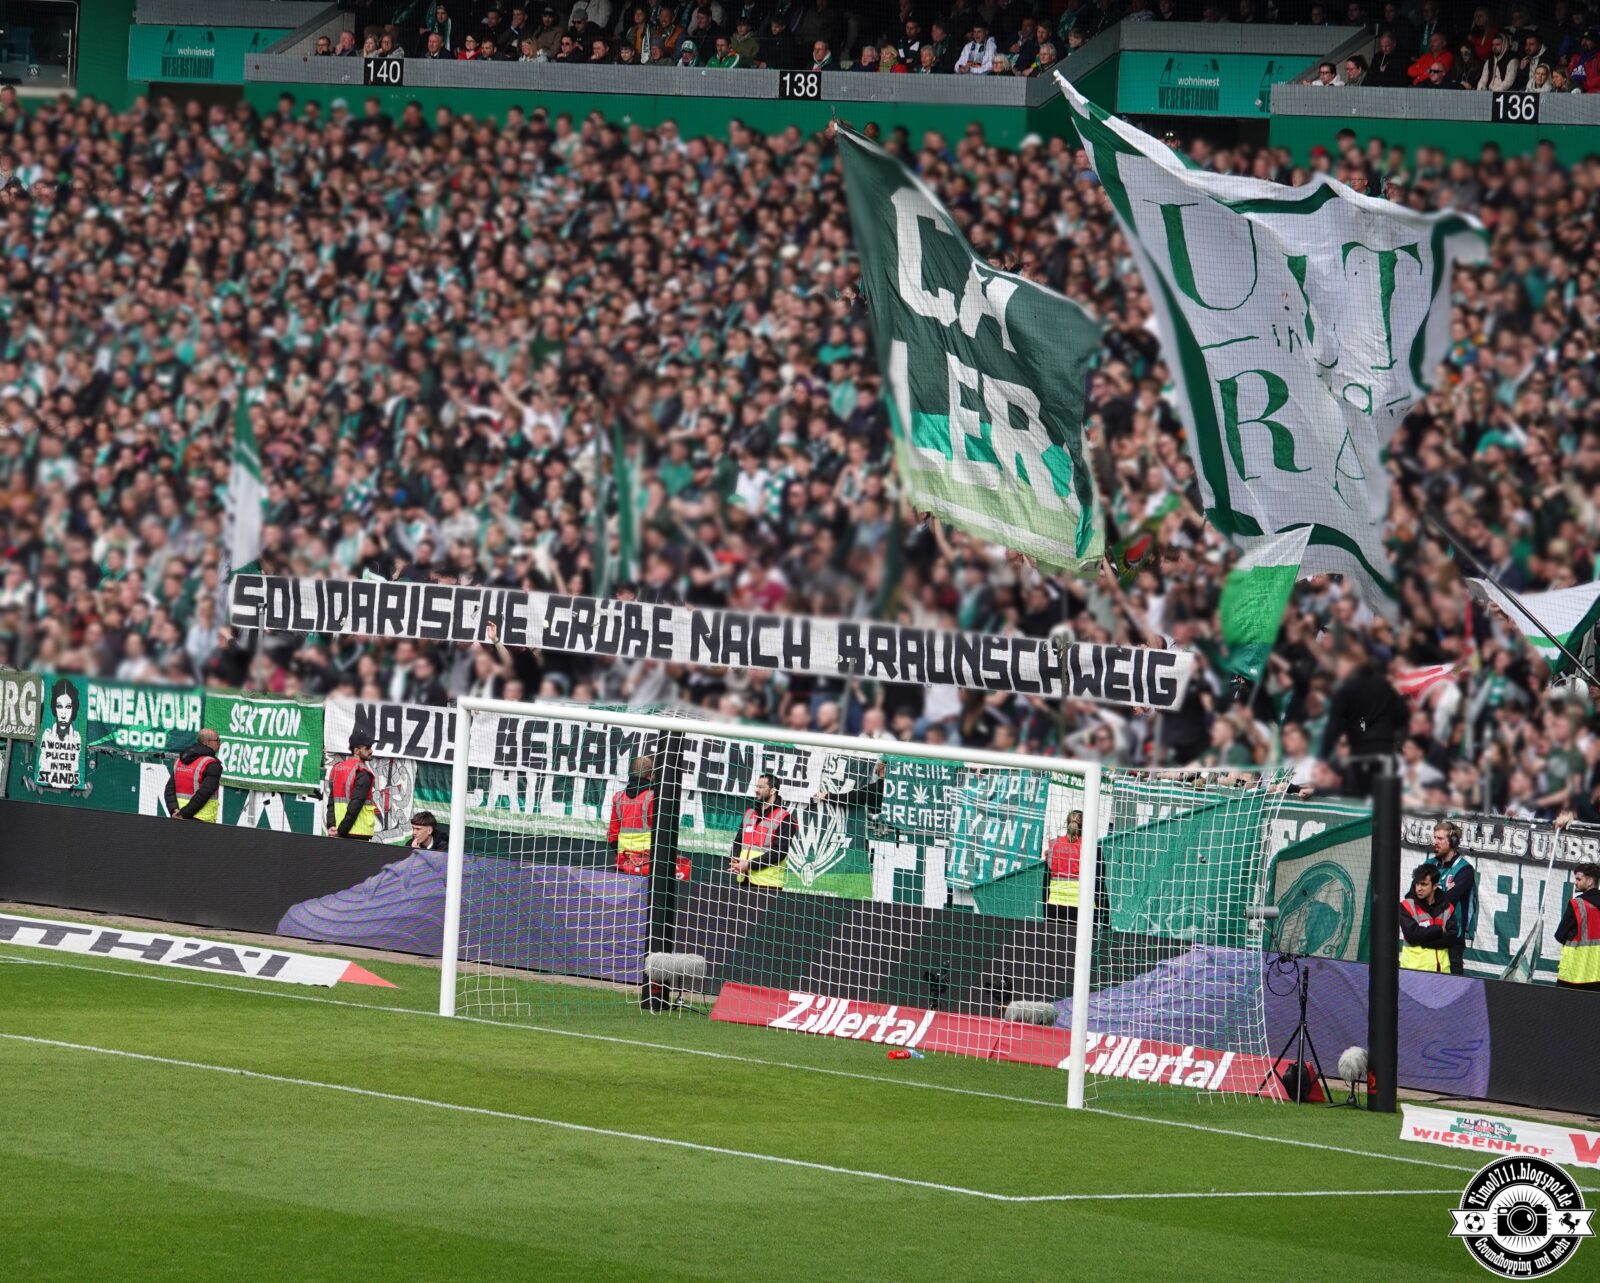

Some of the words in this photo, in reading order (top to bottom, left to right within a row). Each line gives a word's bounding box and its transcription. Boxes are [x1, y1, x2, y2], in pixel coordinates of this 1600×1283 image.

[177, 46, 215, 57] wohninvest
[366, 60, 400, 84] 140
[1177, 76, 1220, 87] wohninvest
[782, 73, 818, 97] 138
[1158, 87, 1219, 112] WESERSTADION
[1495, 94, 1536, 120] 136
[233, 575, 528, 646] SOLIDARISCHE
[690, 609, 811, 669] NACH
[838, 623, 1177, 707] BRAUNSCHWEIG
[88, 685, 201, 732] ENDEAVOUR
[229, 702, 302, 738] SEKTION
[116, 729, 167, 748] 3000
[46, 752, 69, 761] PLACE
[70, 753, 76, 761] IS
[50, 763, 59, 771] IN
[59, 763, 72, 771] THE
[218, 741, 309, 779] REISELUST
[38, 771, 80, 784] STANDS
[883, 779, 909, 800] DE
[1501, 826, 1529, 857] IS
[768, 992, 936, 1048] Zillertal
[1412, 1126, 1554, 1157] WIESENHOF
